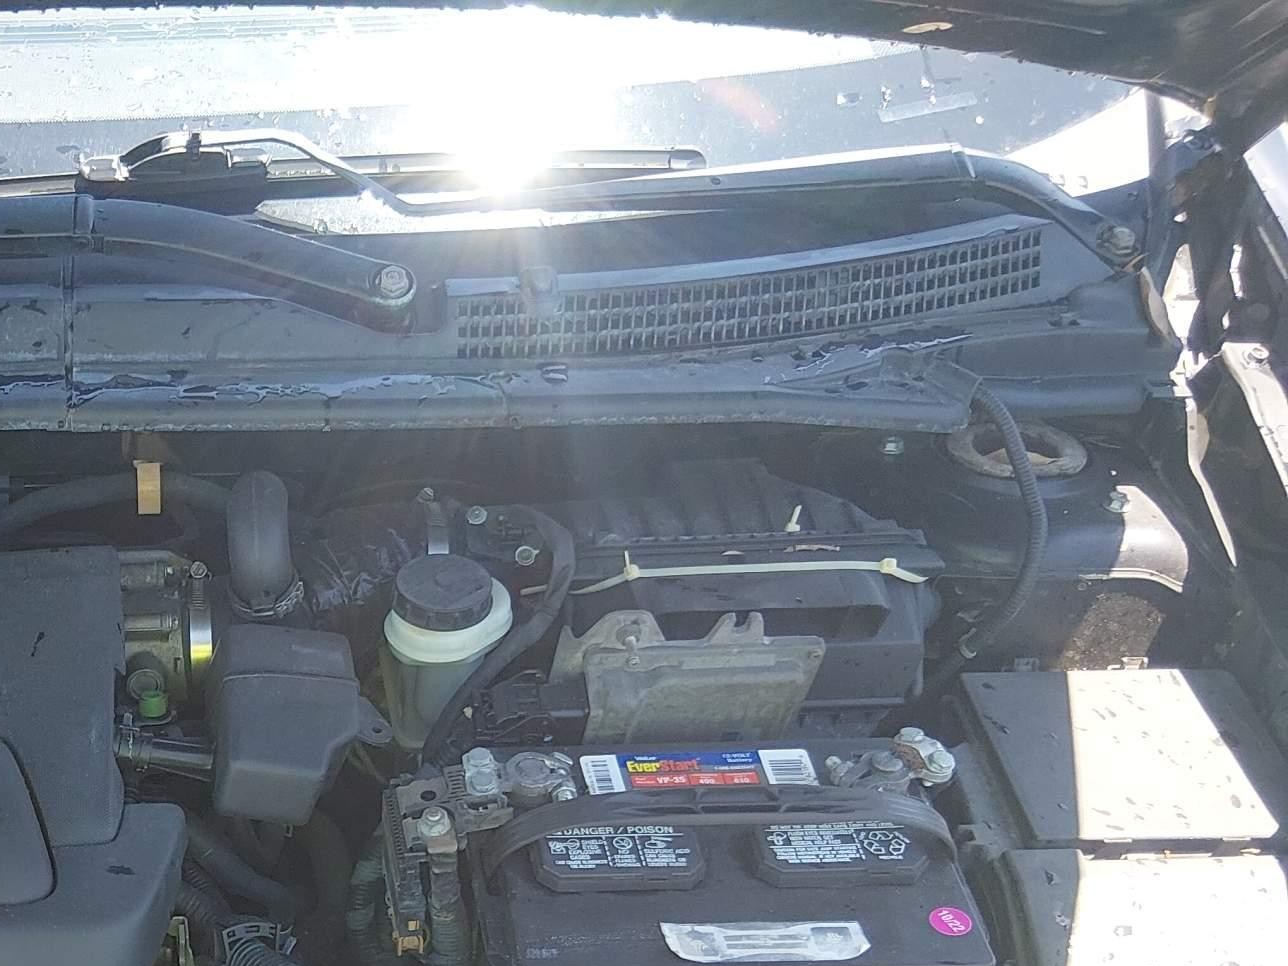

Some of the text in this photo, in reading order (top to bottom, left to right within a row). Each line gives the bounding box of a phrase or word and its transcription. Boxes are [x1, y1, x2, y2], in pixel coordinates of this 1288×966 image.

[626, 759, 698, 773] EverStart
[627, 825, 674, 834] POISON
[937, 909, 966, 933] 10/22
